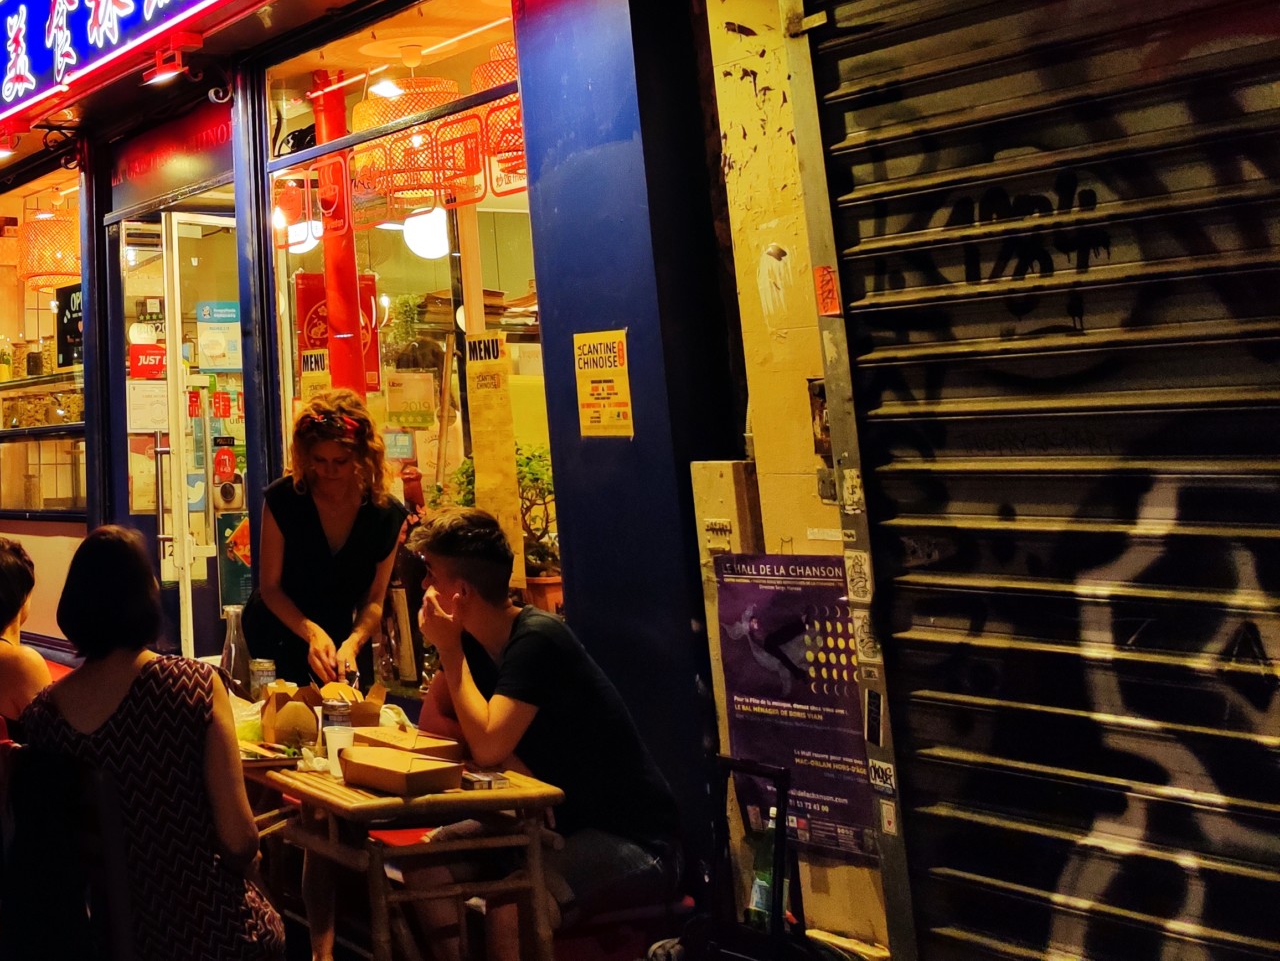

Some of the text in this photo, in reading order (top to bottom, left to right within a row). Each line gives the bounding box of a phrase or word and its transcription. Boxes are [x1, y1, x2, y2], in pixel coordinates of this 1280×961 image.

[468, 338, 500, 362] MENU
[582, 341, 617, 357] CANTINE
[138, 355, 162, 366] JUST
[302, 352, 326, 372] MENU
[577, 355, 619, 370] CHINOISE
[401, 400, 431, 412] 2019
[721, 563, 843, 578] LE HALL DE LA CHANSON
